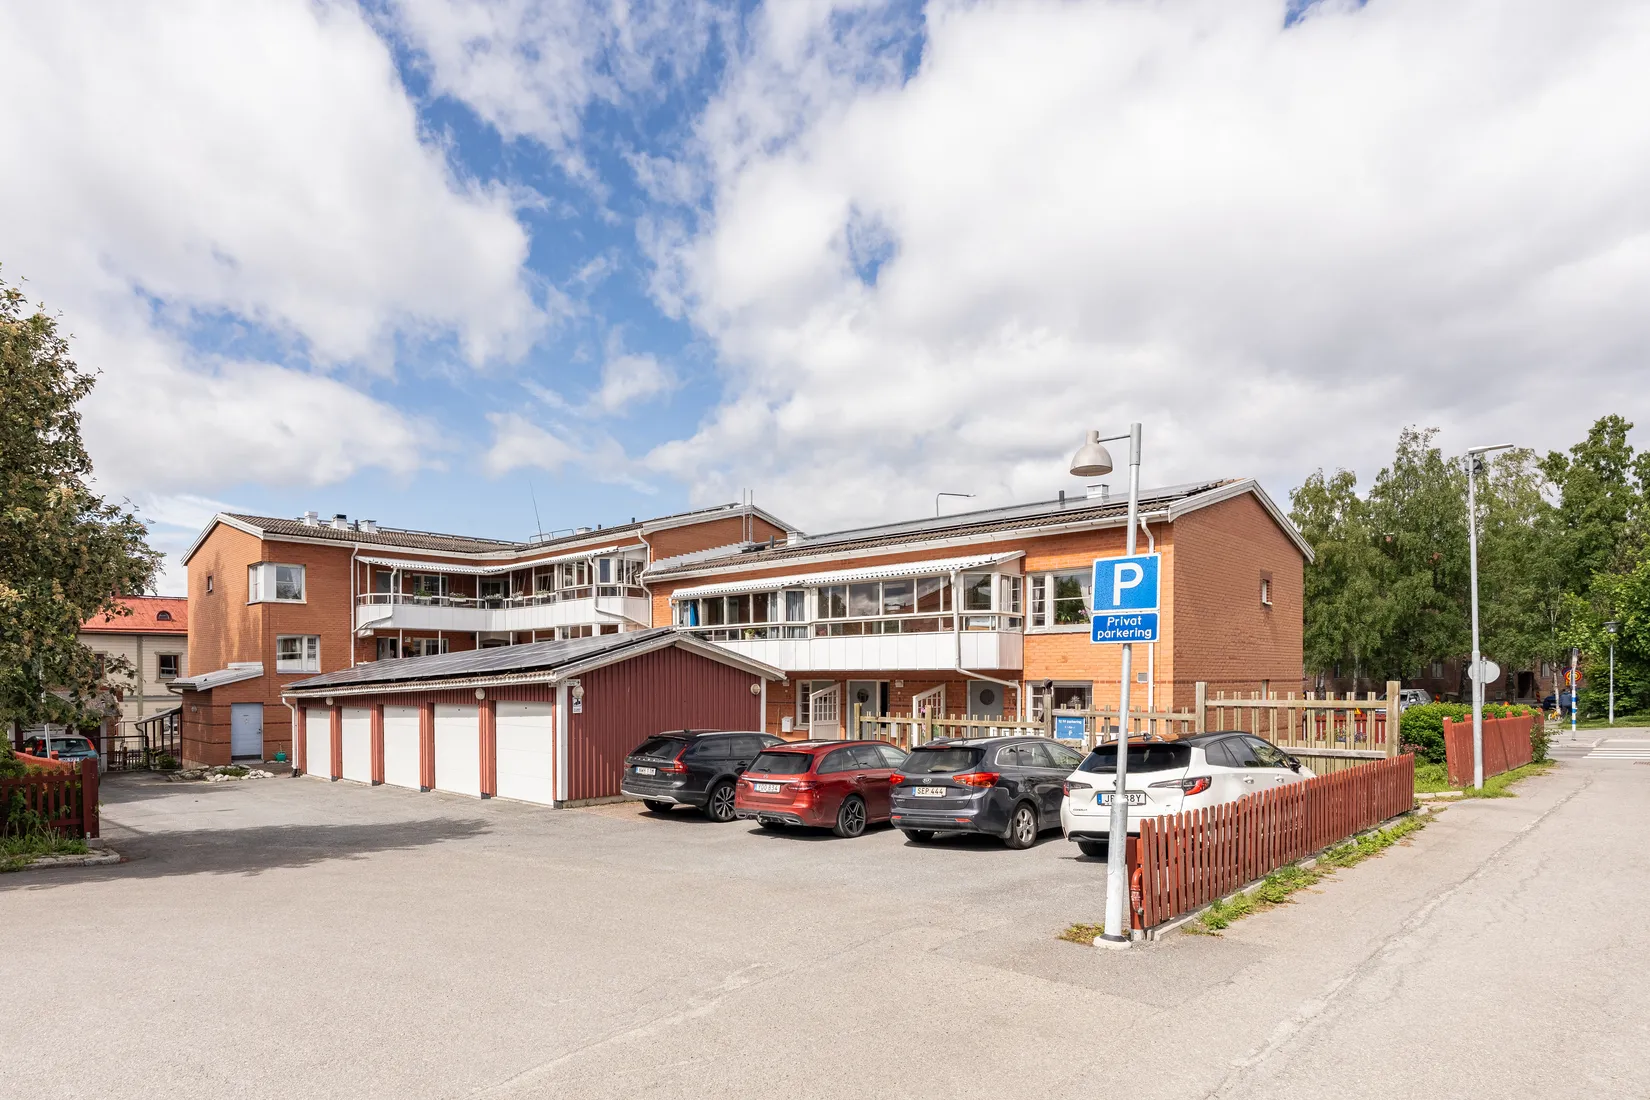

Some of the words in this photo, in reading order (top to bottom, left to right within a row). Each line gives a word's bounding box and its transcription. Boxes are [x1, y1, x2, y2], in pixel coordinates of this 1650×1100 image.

[1113, 562, 1144, 606] P
[1107, 616, 1142, 626] Privat
[1097, 627, 1152, 640] parkering
